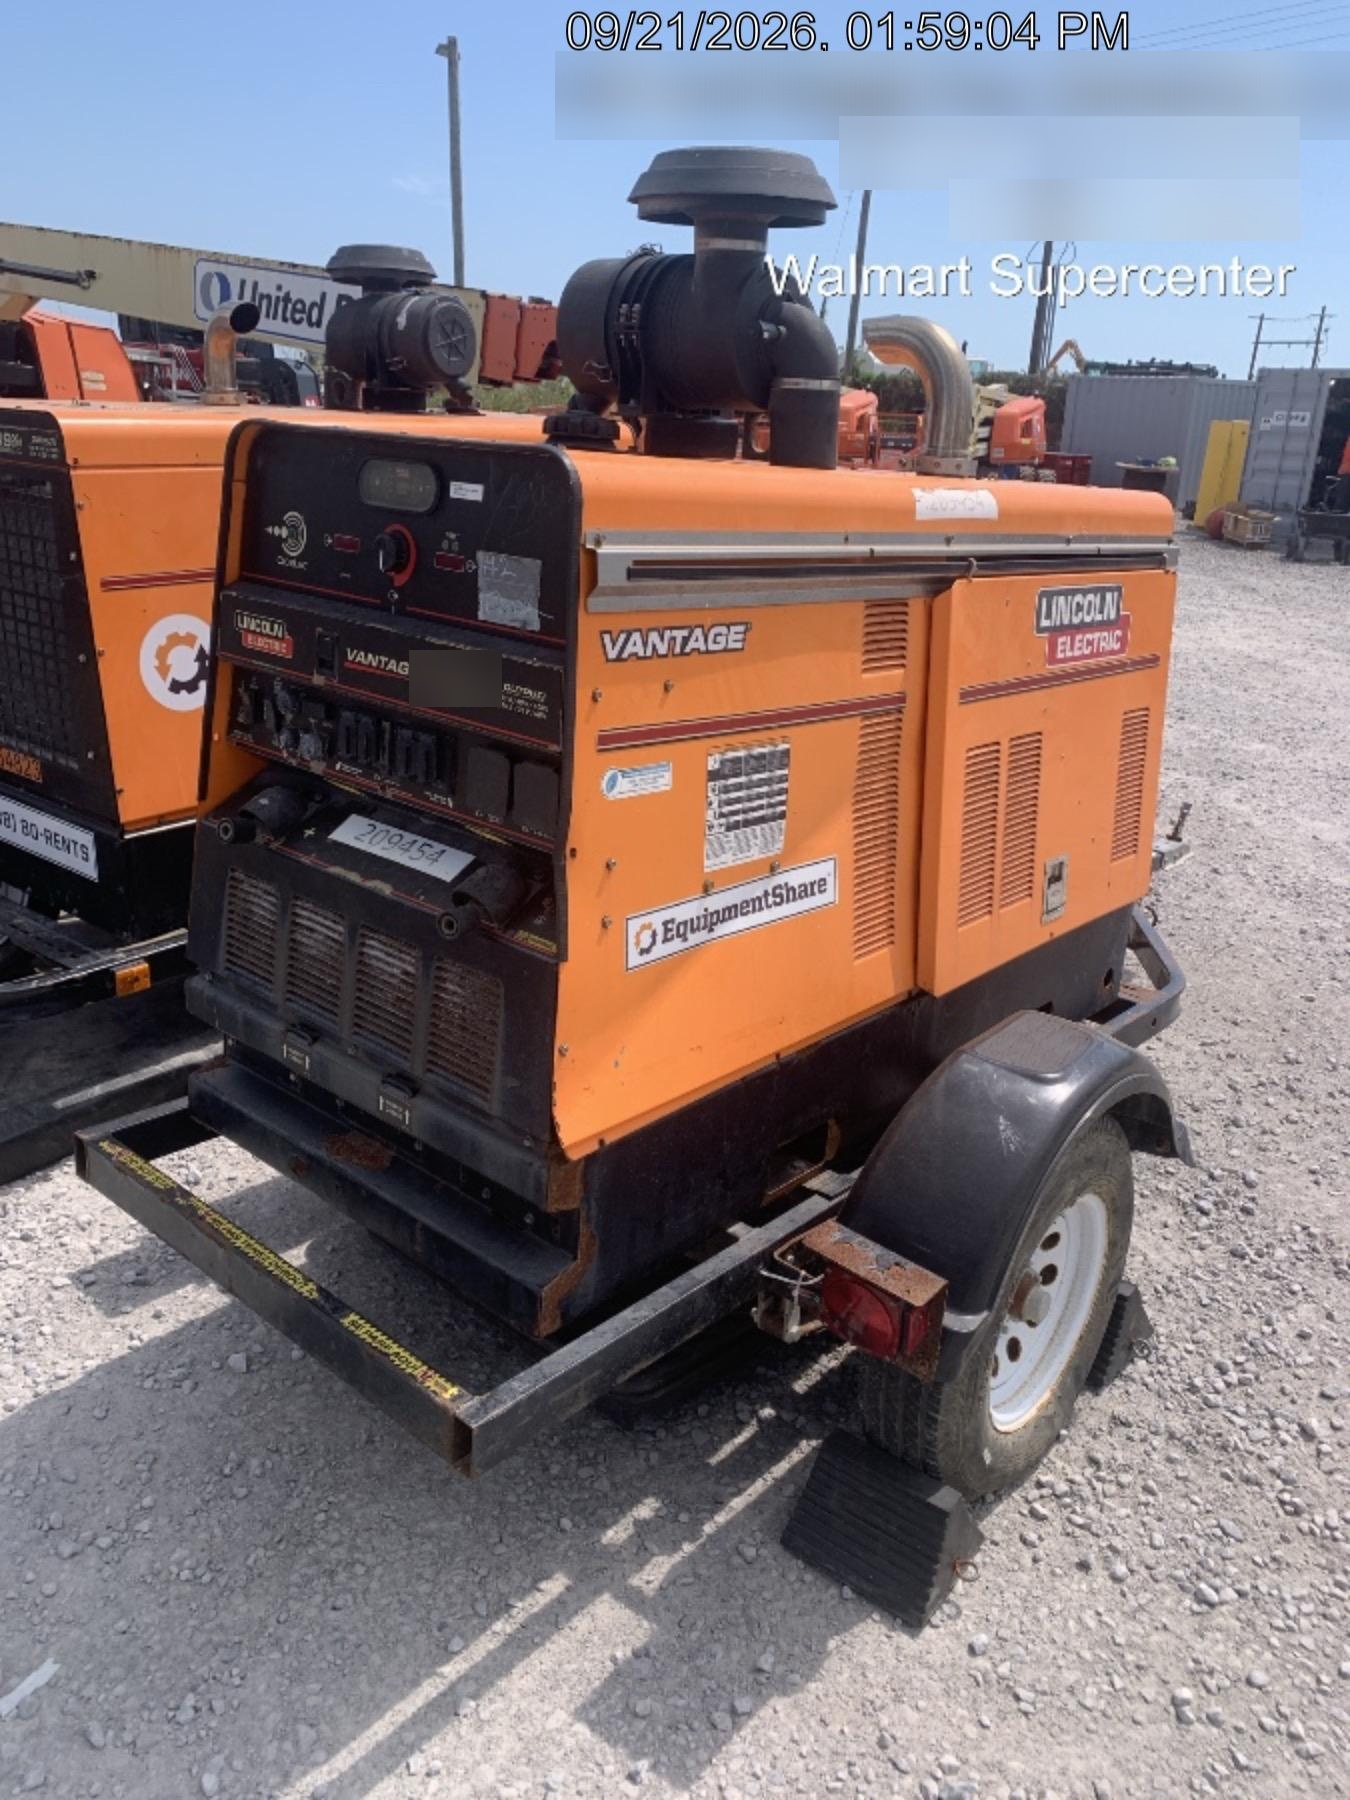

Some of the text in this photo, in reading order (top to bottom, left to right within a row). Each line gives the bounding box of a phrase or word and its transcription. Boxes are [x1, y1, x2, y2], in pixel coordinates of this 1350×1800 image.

[237, 278, 327, 329] United
[236, 613, 284, 638] LINCOLN
[1040, 591, 1119, 627] LINCOLN
[600, 623, 746, 662] VANTAGE
[1056, 629, 1122, 659] ELECTRIC
[346, 648, 409, 675] VANTAG
[661, 876, 828, 945] EquipmentShare
